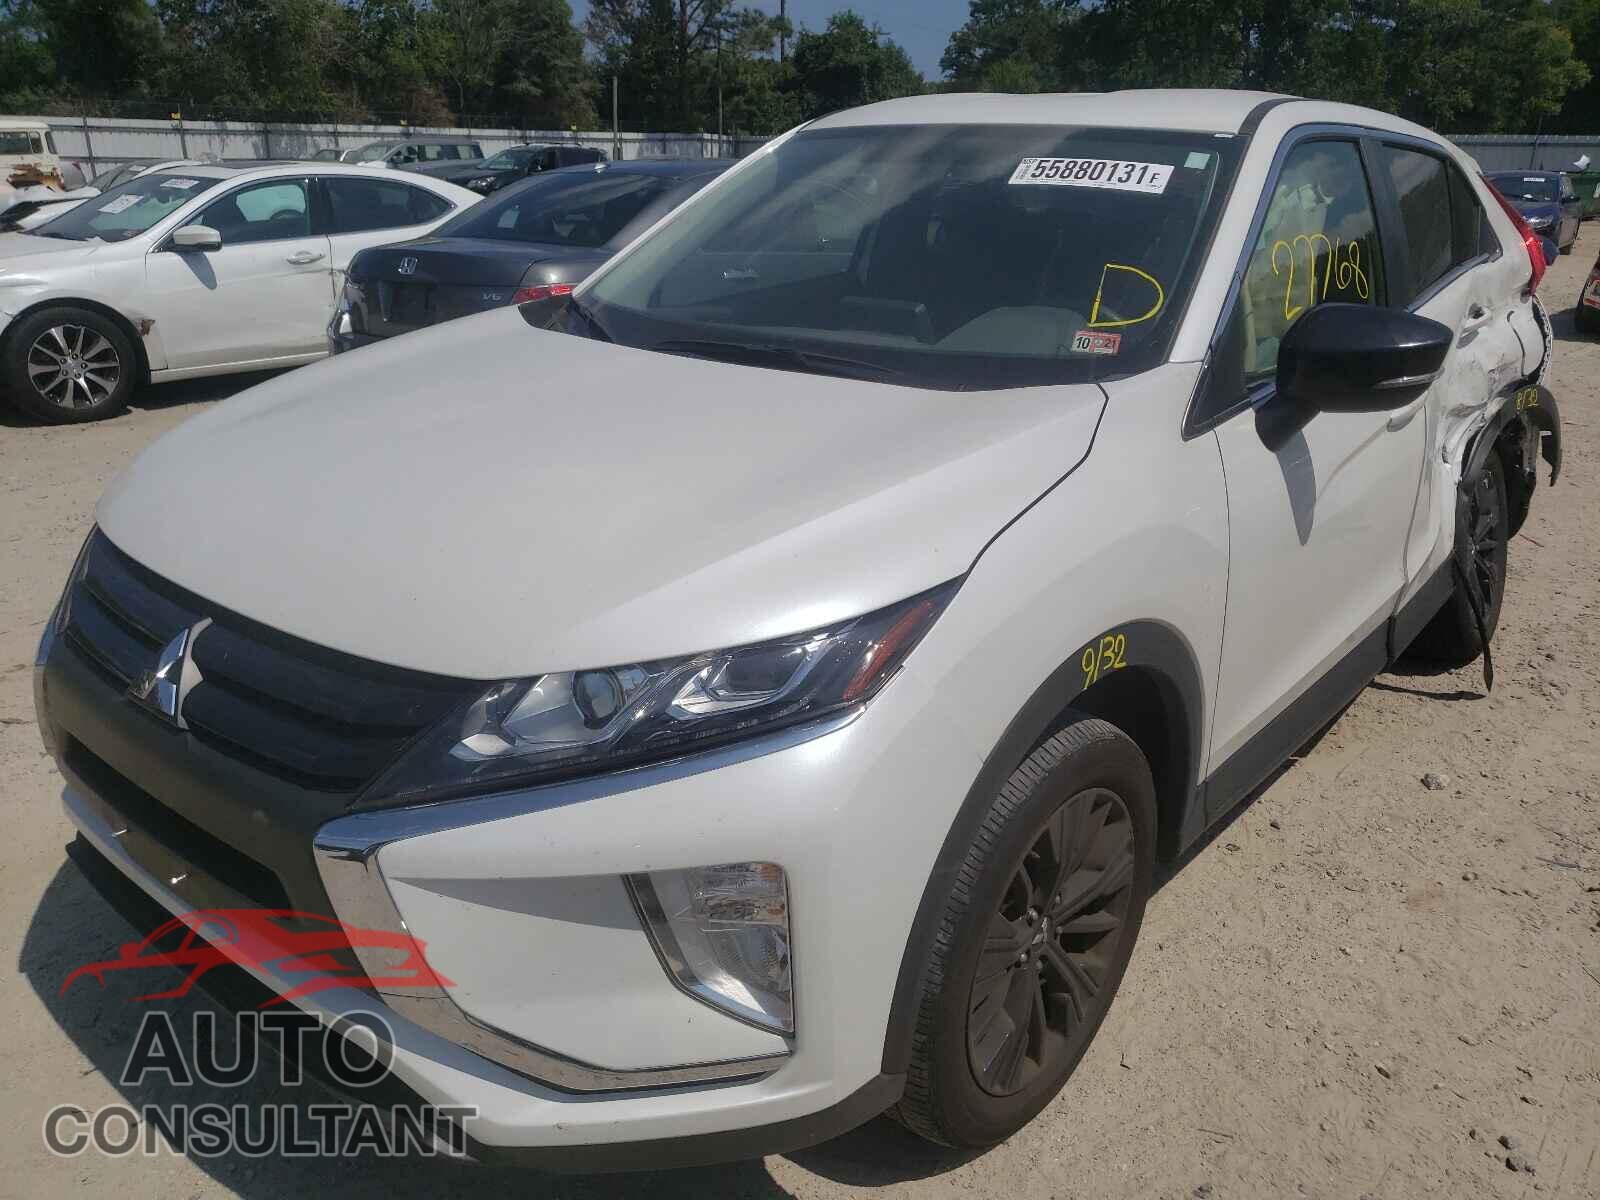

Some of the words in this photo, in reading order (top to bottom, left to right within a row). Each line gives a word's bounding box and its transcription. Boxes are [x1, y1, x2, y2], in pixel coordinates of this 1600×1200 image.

[1030, 159, 1149, 185] 55880131
[1149, 172, 1161, 184] F
[1087, 263, 1166, 328] D
[1271, 232, 1369, 320] 27768
[1076, 336, 1091, 349] 10
[1081, 633, 1128, 689] 9/32
